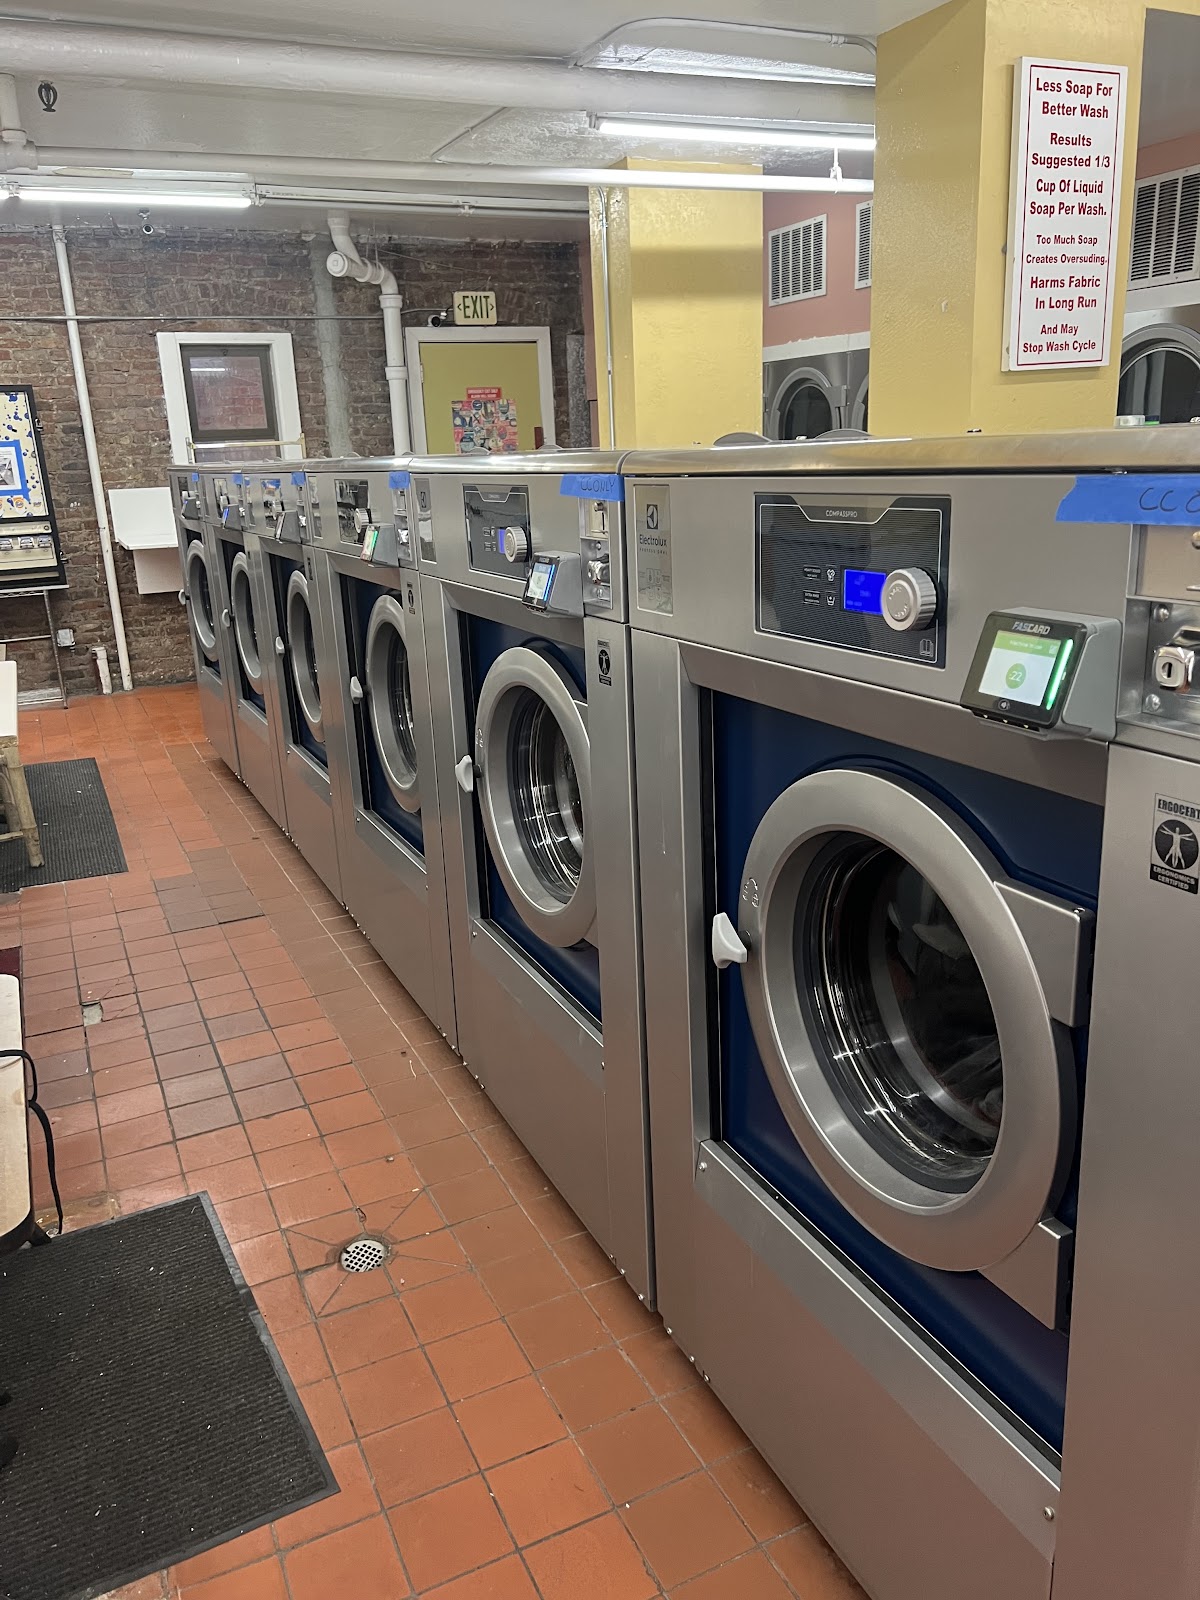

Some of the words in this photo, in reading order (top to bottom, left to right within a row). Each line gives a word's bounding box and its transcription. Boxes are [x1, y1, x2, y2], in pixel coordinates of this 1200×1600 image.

[1036, 78, 1062, 92] Less
[1065, 80, 1093, 98] Soap
[1096, 83, 1113, 97] For
[1042, 101, 1077, 116] Better
[1080, 103, 1109, 118] Wash
[1050, 132, 1092, 147] Results
[1031, 153, 1091, 169] Suggested
[1095, 155, 1111, 168] 1/3
[1036, 178, 1056, 195] Cup
[1059, 179, 1071, 193] Of
[1073, 179, 1104, 196] Liquid
[1030, 201, 1055, 218] Soap
[1058, 202, 1075, 215] Per
[1078, 202, 1107, 215] Wash.
[1036, 234, 1051, 244] Too
[1054, 234, 1075, 244] Much
[1077, 234, 1098, 246] Soap
[1026, 254, 1058, 263] Creates
[1060, 253, 1107, 265] Oversuding.
[1030, 276, 1065, 288] Harms
[1068, 275, 1101, 288] Fabric
[462, 295, 490, 319] EXIT
[1035, 297, 1045, 309] In
[1049, 296, 1074, 311] Long
[1077, 296, 1097, 308] Run
[1040, 324, 1058, 334] And
[1060, 323, 1079, 336] May
[1023, 342, 1043, 354] Stop
[1046, 341, 1069, 351] Wash
[1072, 340, 1096, 352] Cycle
[1139, 487, 1178, 512] CC
[825, 509, 858, 518] COMPASSPRO
[639, 534, 667, 547] Electrolux
[1011, 621, 1051, 635] FASCARD
[1157, 798, 1200, 820] ERGOCERT
[1153, 865, 1196, 885] ERGONOMICS
[1157, 874, 1190, 890] CERTIFIED
